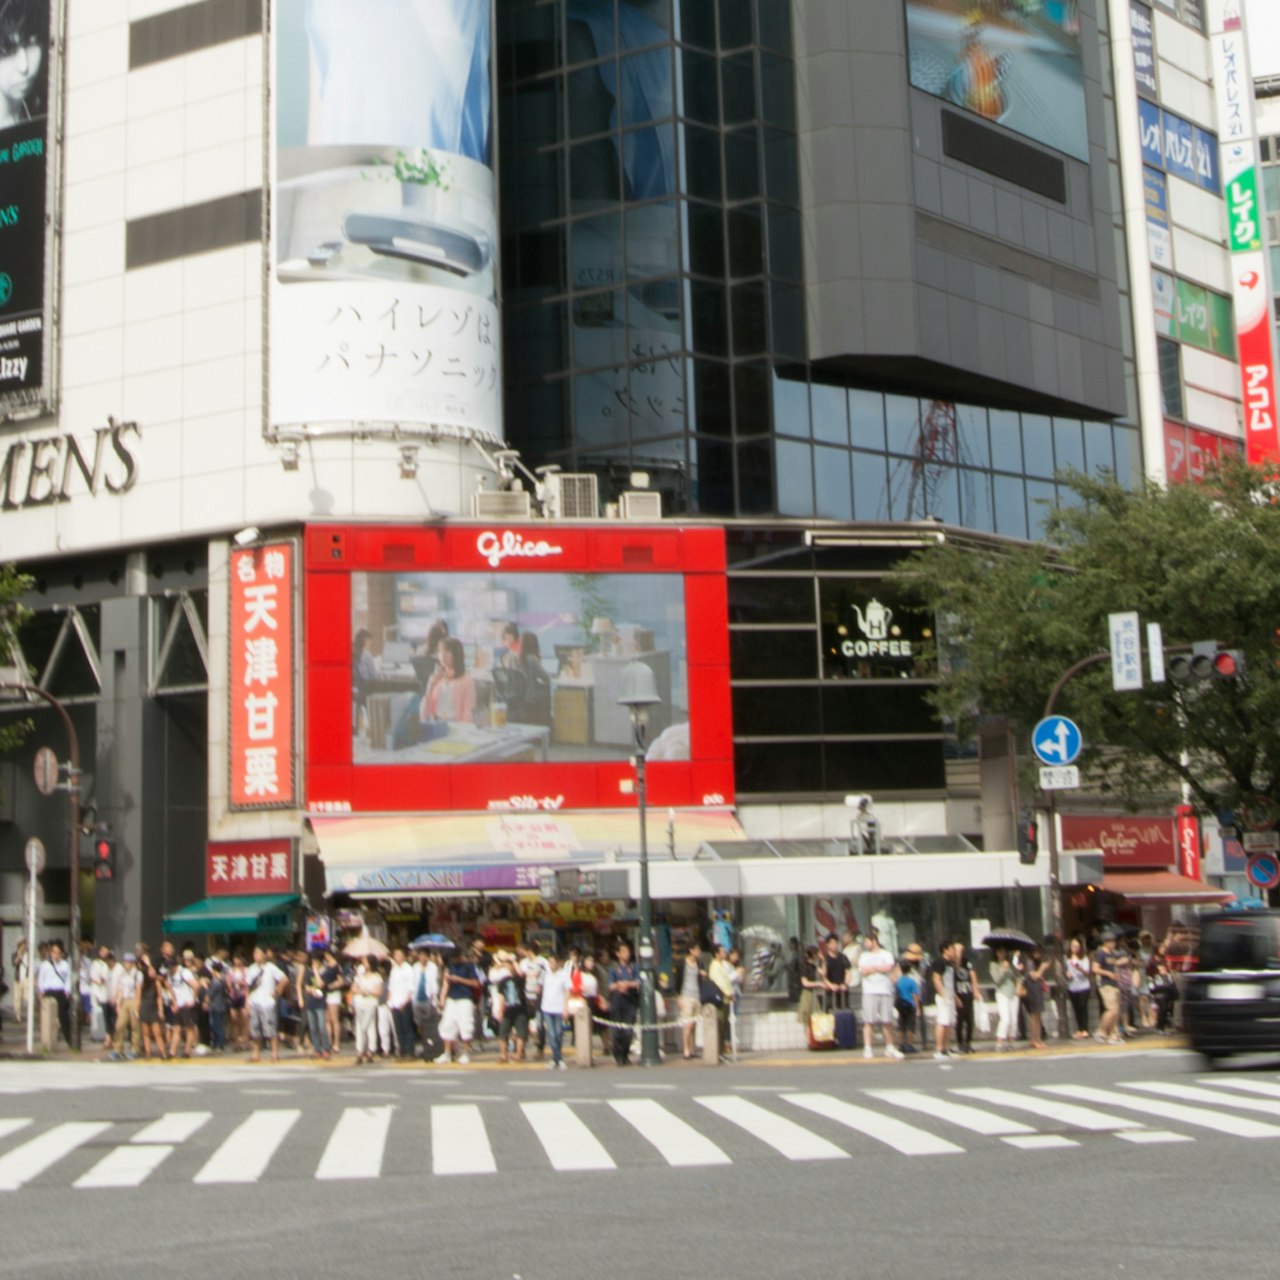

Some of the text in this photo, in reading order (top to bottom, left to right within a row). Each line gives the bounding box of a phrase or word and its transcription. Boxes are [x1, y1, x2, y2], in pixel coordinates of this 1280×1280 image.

[1222, 38, 1243, 136] レオパレス21
[1231, 181, 1256, 245] レイク
[1178, 295, 1207, 331] レイク
[1245, 364, 1273, 432] アコム
[841, 640, 912, 658] COFFEE
[243, 584, 279, 797] 天津甘栗
[211, 853, 289, 882] 天津甘栗
[521, 900, 560, 919] TAX
[572, 899, 616, 918] Free
